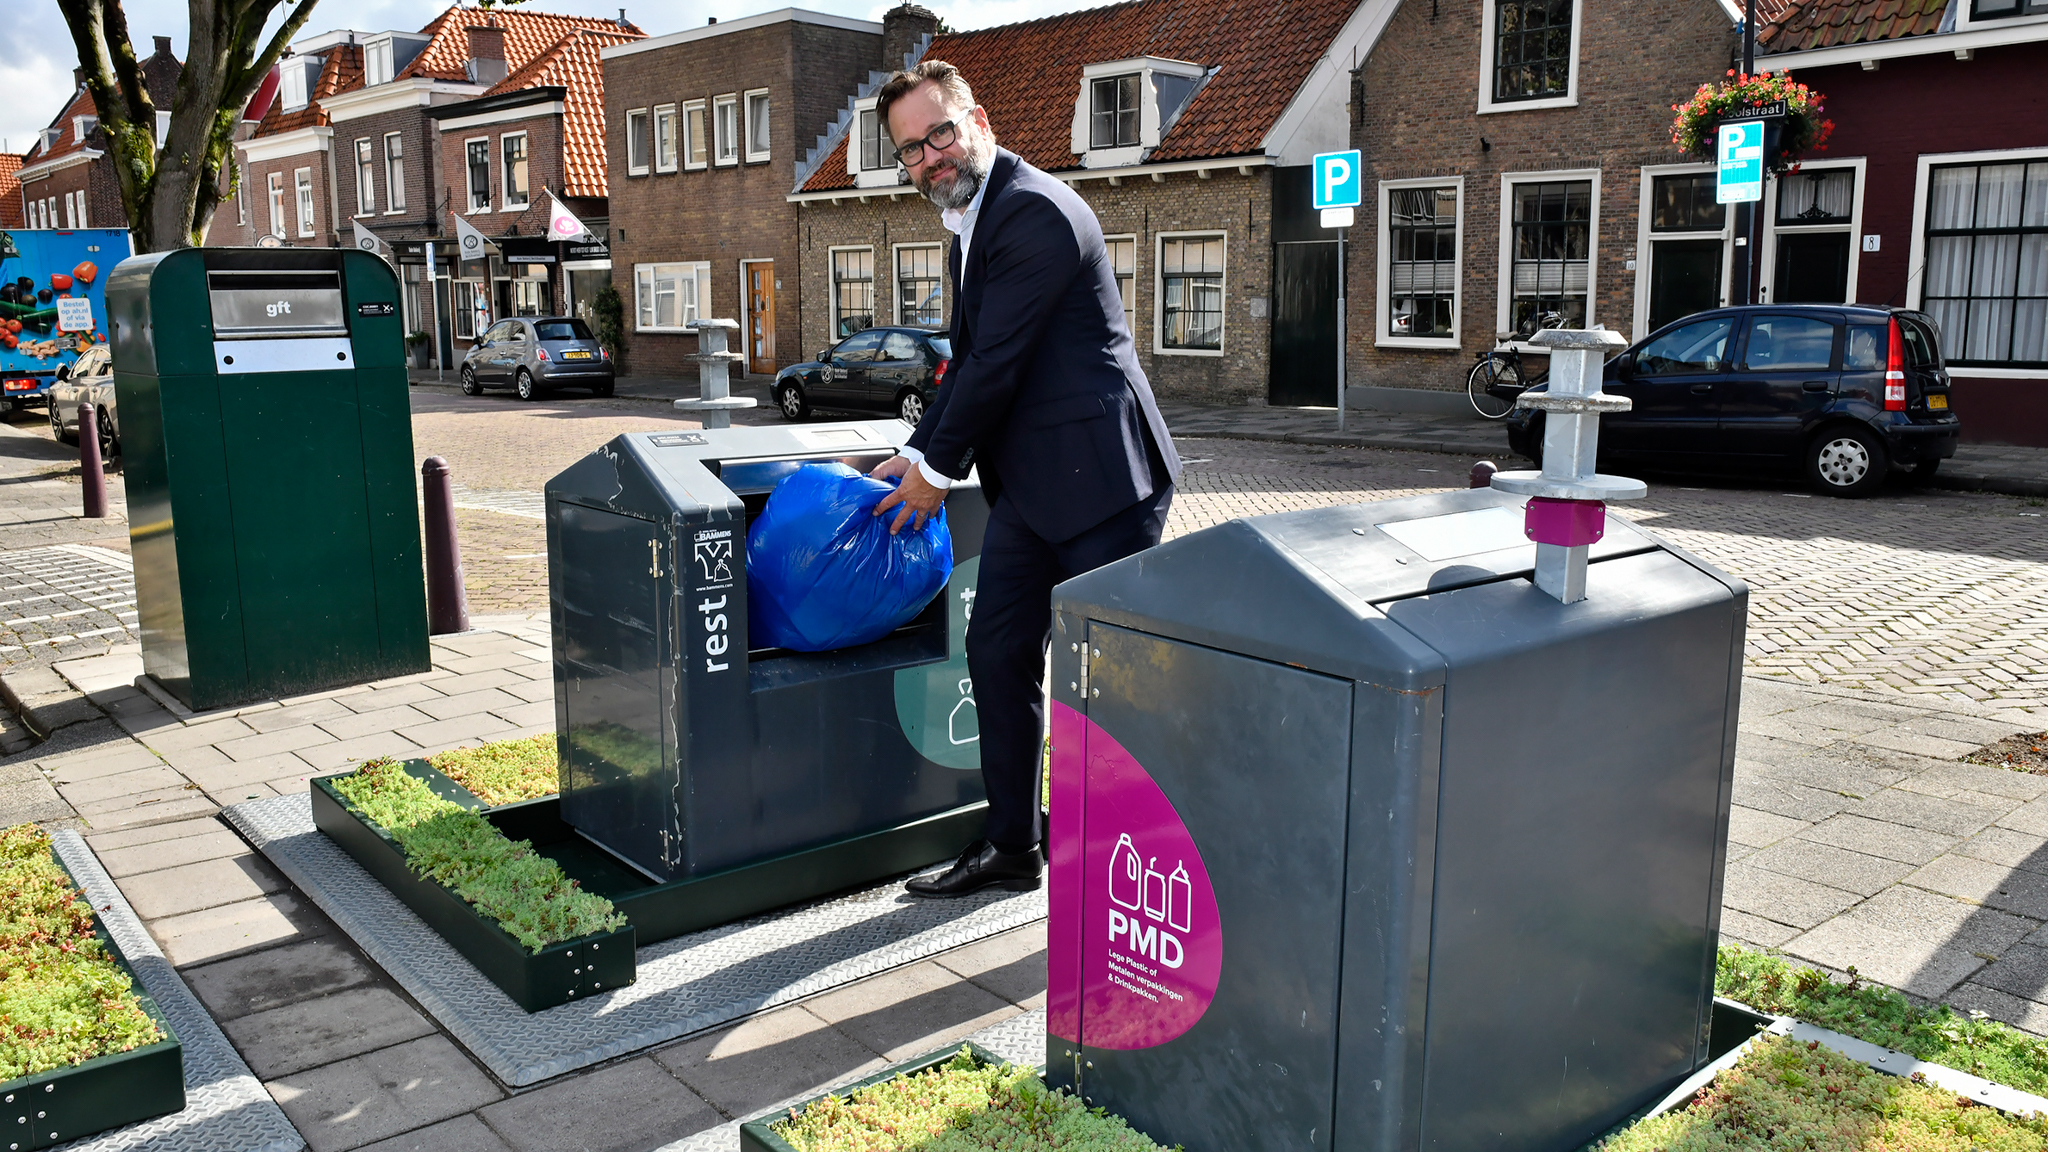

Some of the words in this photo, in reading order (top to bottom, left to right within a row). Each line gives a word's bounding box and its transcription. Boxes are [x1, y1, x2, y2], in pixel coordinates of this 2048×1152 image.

[1722, 127, 1746, 160] P
[1325, 158, 1351, 202] P
[1869, 236, 1875, 250] 8
[266, 300, 292, 317] gft
[700, 530, 732, 541] BAMMENS
[696, 583, 734, 592] www.bammens.com
[698, 594, 729, 673] rest
[1108, 908, 1184, 969] PMD
[1108, 948, 1125, 963] Lege
[1126, 956, 1149, 974] Plastic
[1149, 969, 1158, 977] of
[1107, 973, 1114, 982] &
[1114, 975, 1159, 1003] Drinkpakken.
[1108, 960, 1135, 980] Metalen
[1136, 974, 1183, 1002] verpakkingen
